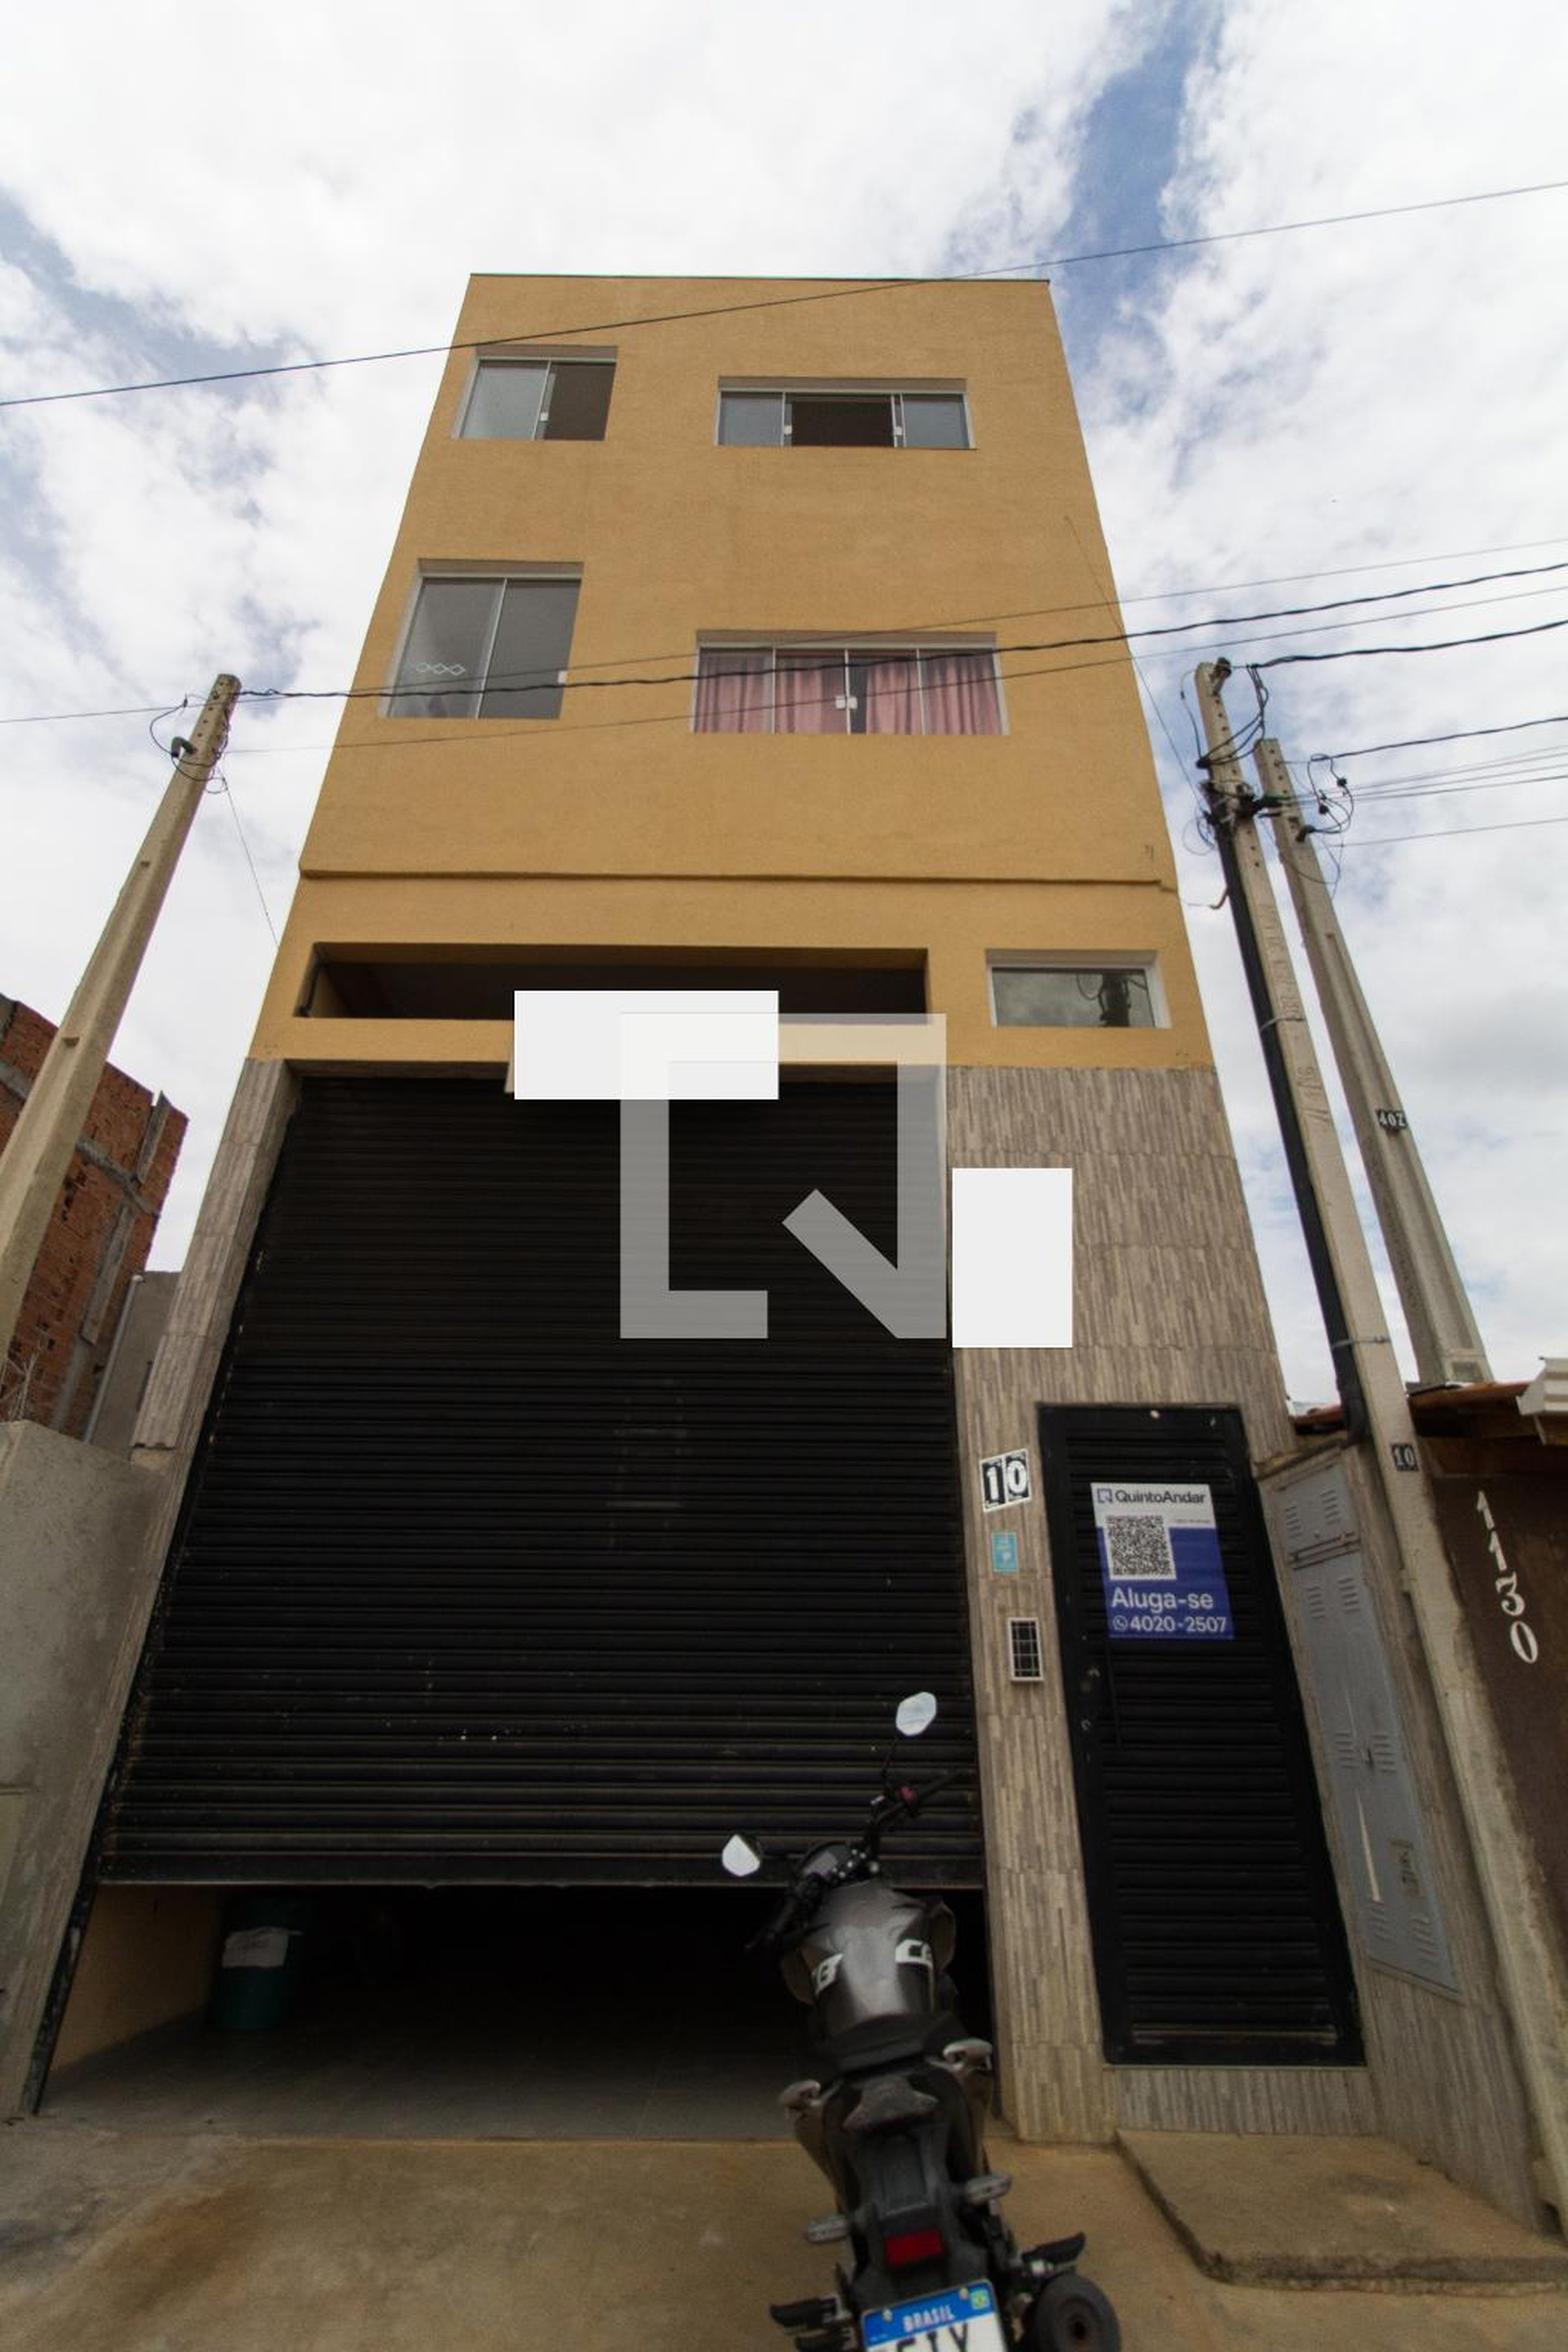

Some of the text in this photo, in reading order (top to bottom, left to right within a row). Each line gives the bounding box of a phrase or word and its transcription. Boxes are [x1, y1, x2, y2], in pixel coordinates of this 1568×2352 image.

[1394, 1446, 1414, 1466] 10
[986, 1459, 1027, 1501] 10
[1114, 1489, 1206, 1503] QuintoAndar
[1477, 1490, 1538, 1664] 1130
[1111, 1586, 1214, 1614] Aluga-se
[1130, 1615, 1227, 1632] 4020-2507
[902, 2304, 956, 2332] BRASIL
